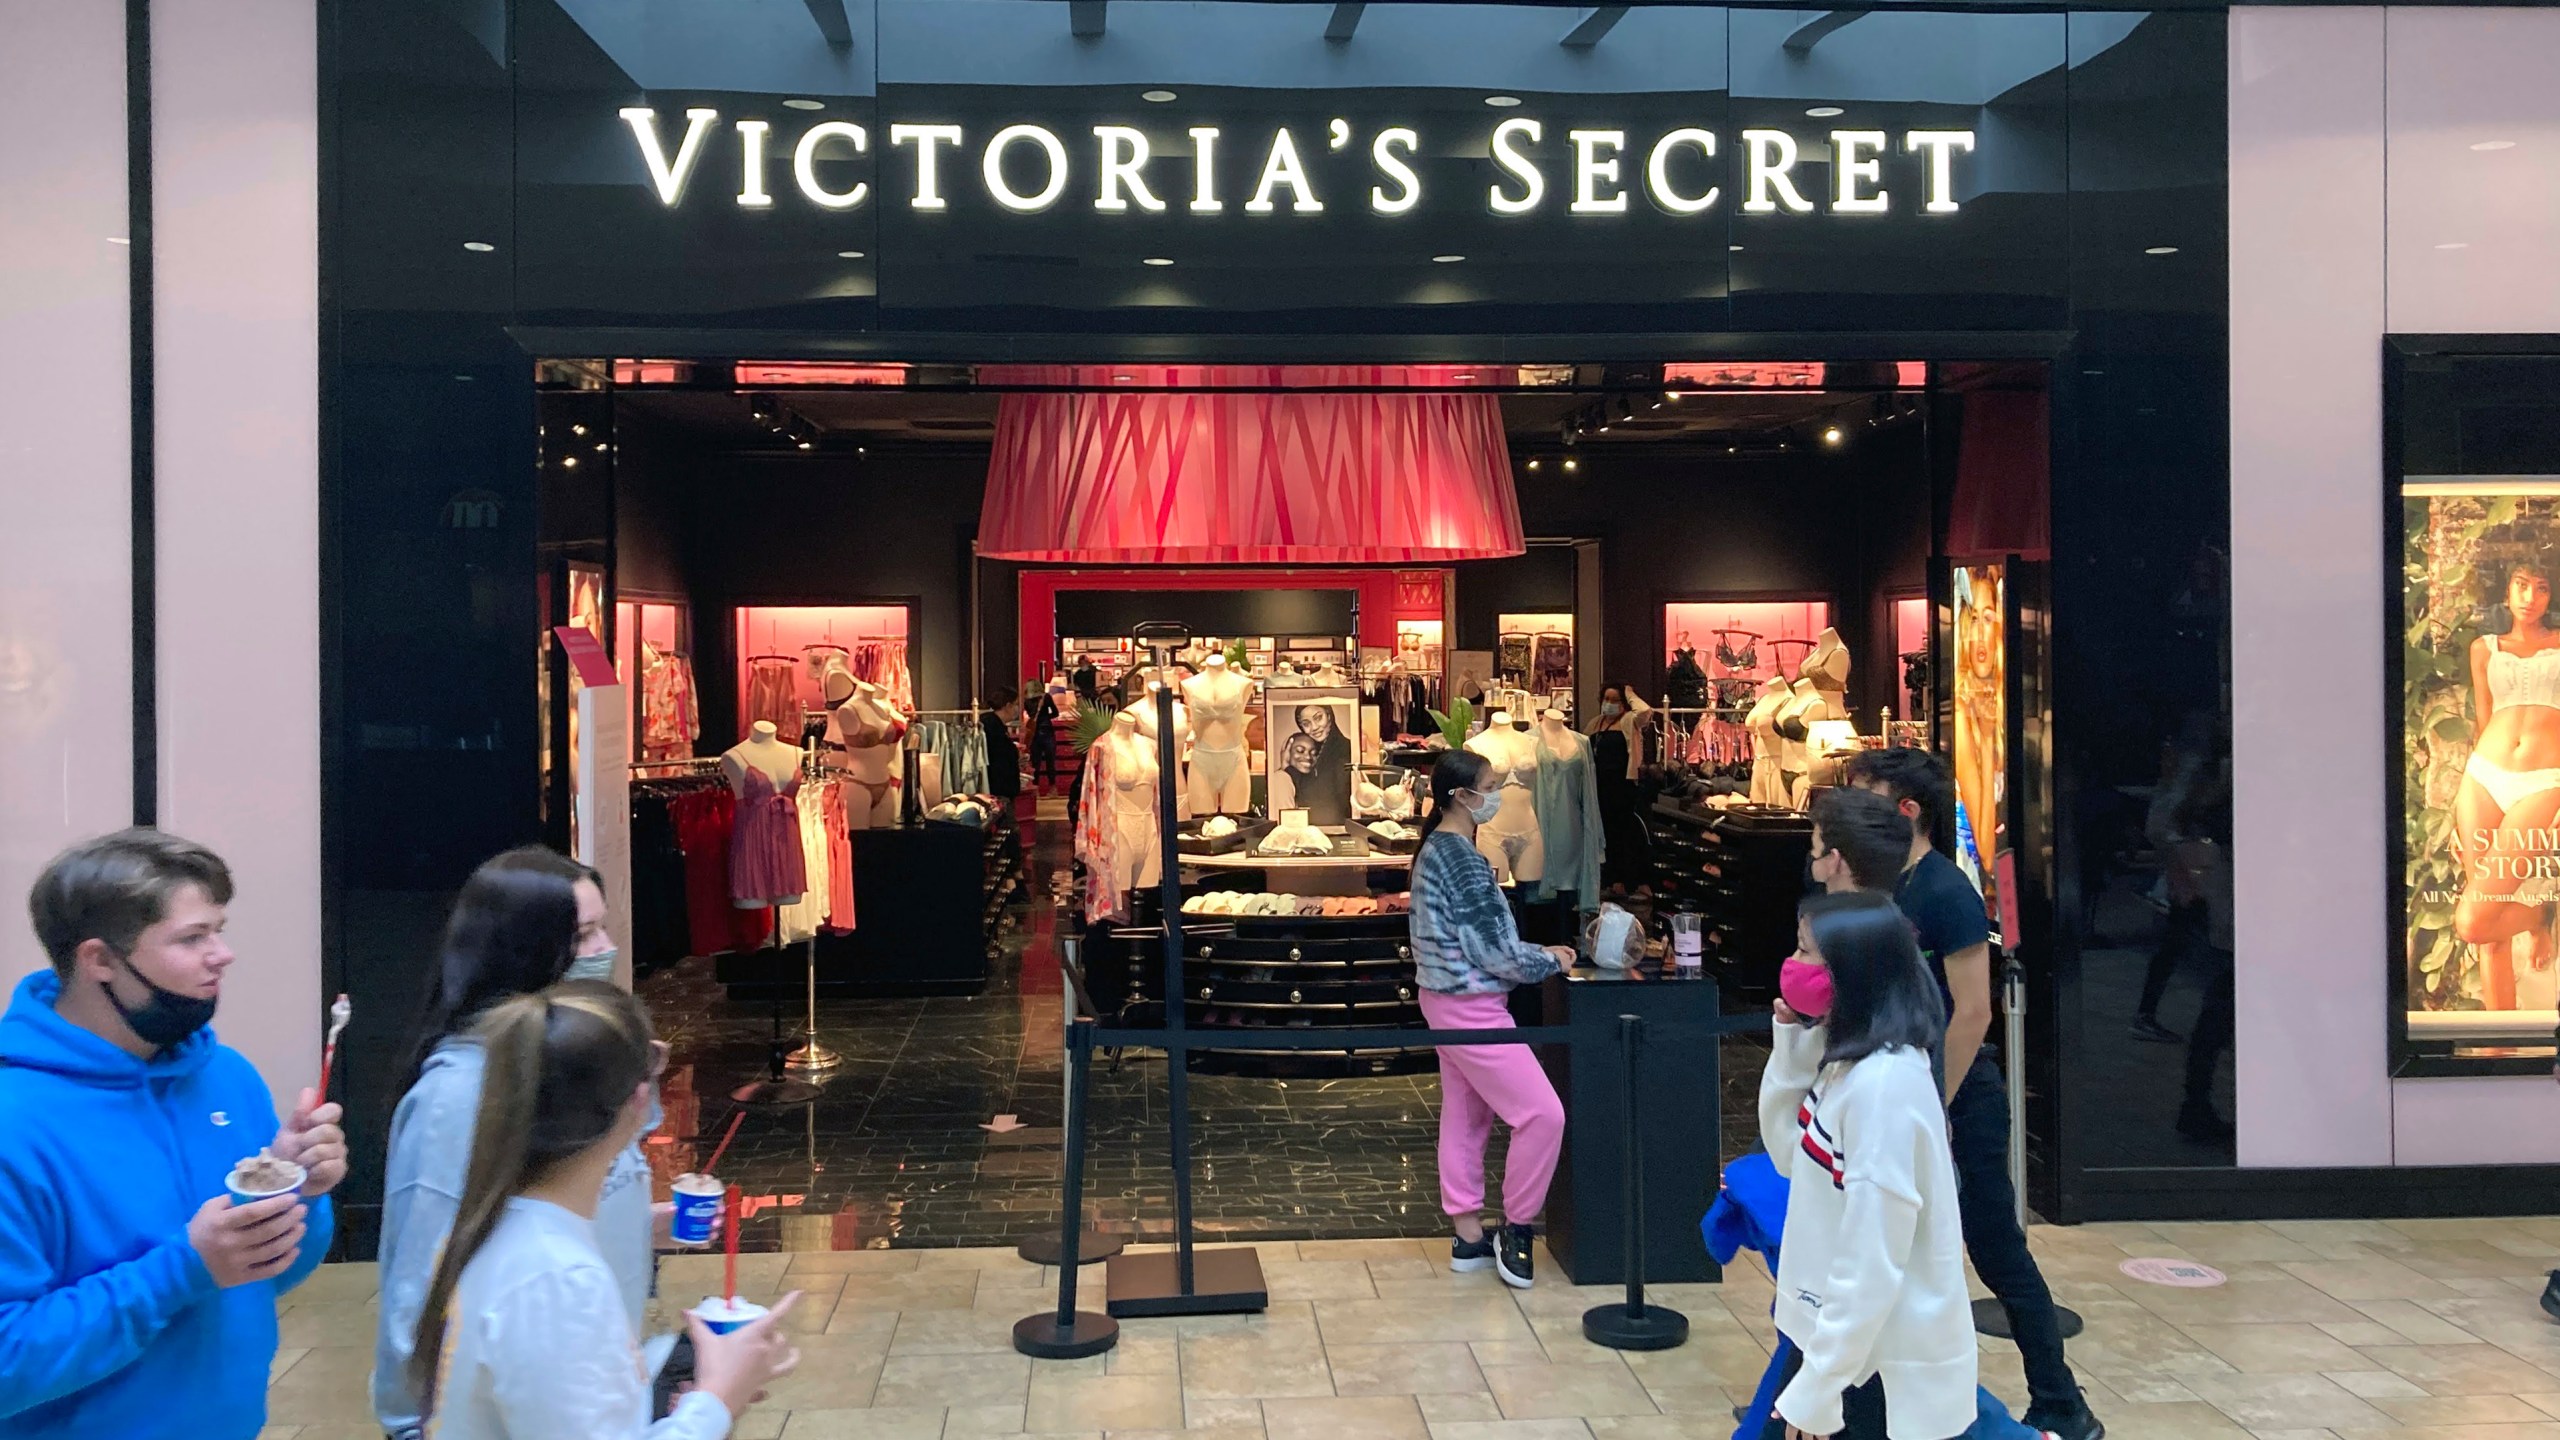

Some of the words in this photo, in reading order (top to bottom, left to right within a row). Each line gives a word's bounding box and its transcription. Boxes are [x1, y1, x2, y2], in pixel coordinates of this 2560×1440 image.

[618, 107, 1422, 213] VICTORIA'S
[1489, 117, 1976, 214] SECRET
[2445, 828, 2464, 851] A
[2421, 890, 2439, 903] All
[2442, 890, 2469, 904] New
[2472, 890, 2514, 903] Dream
[2518, 889, 2559, 905] Angels
